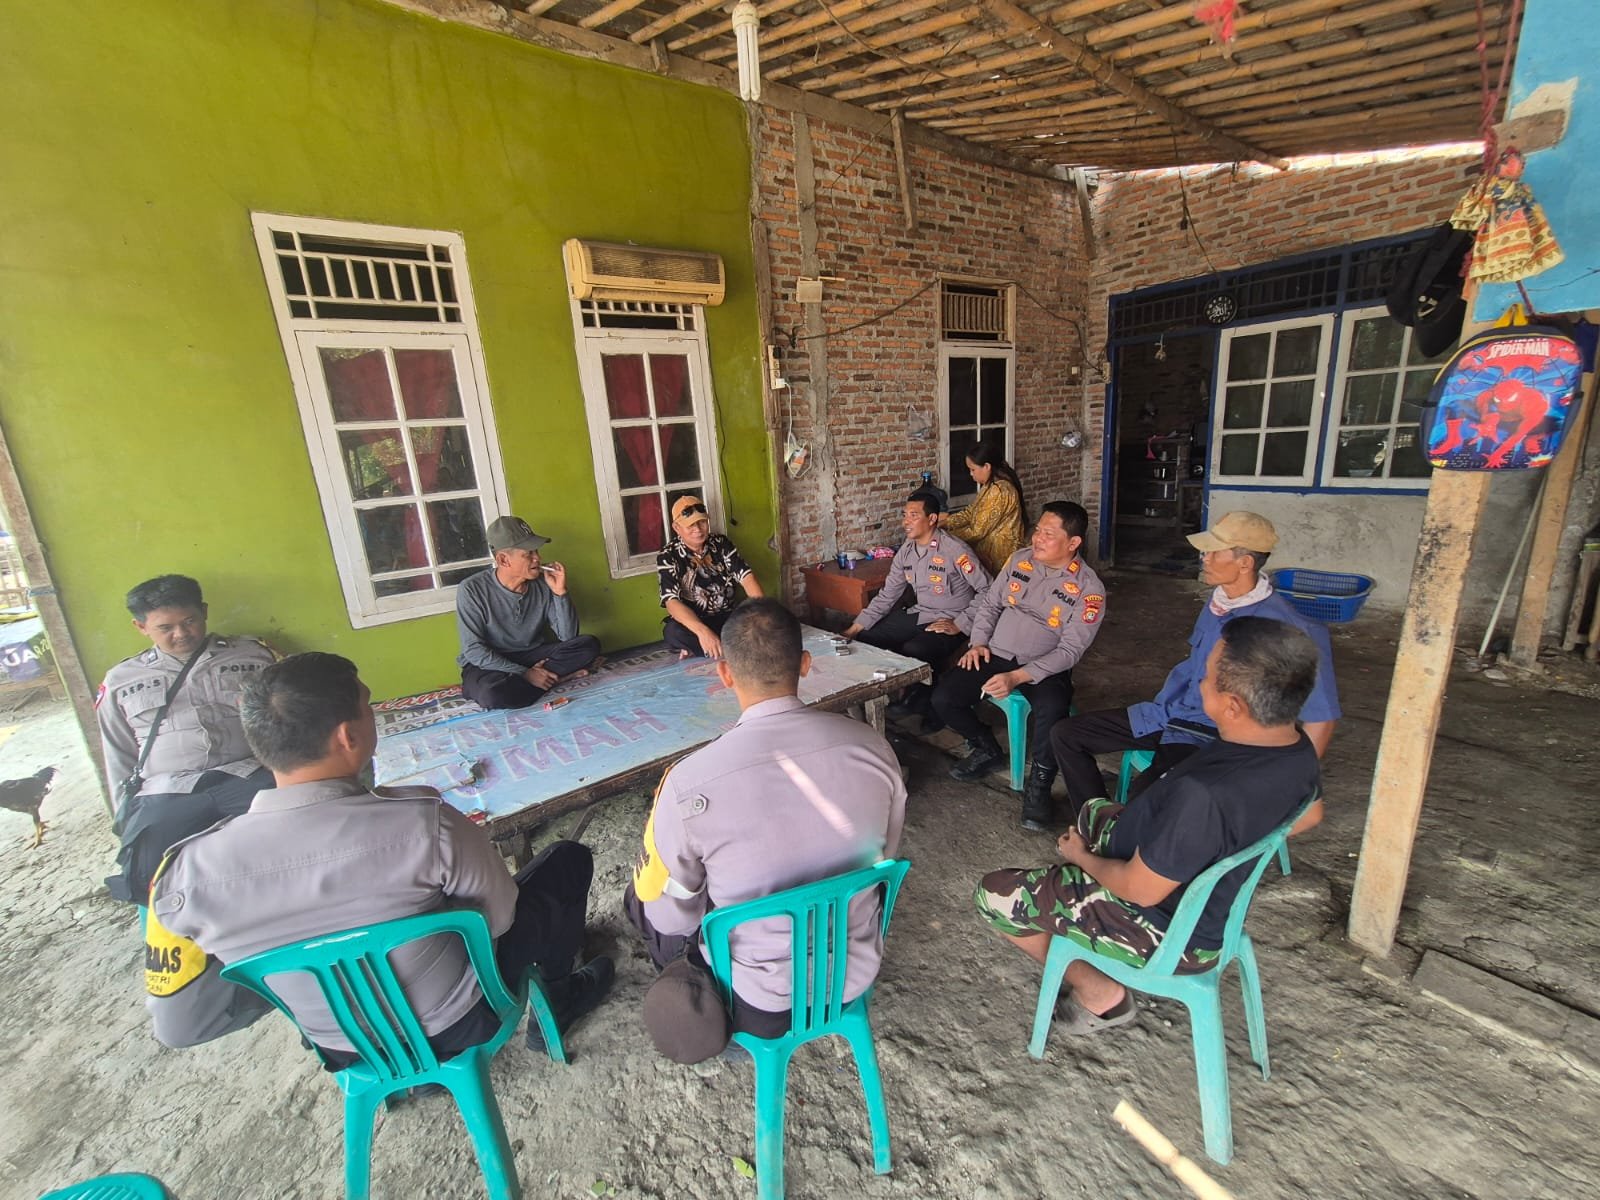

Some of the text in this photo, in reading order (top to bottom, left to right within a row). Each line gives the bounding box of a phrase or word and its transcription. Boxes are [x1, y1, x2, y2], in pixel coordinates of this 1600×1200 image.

[928, 564, 946, 573] POLRI
[1052, 588, 1076, 607] POLRI
[422, 707, 669, 798] UMAH
